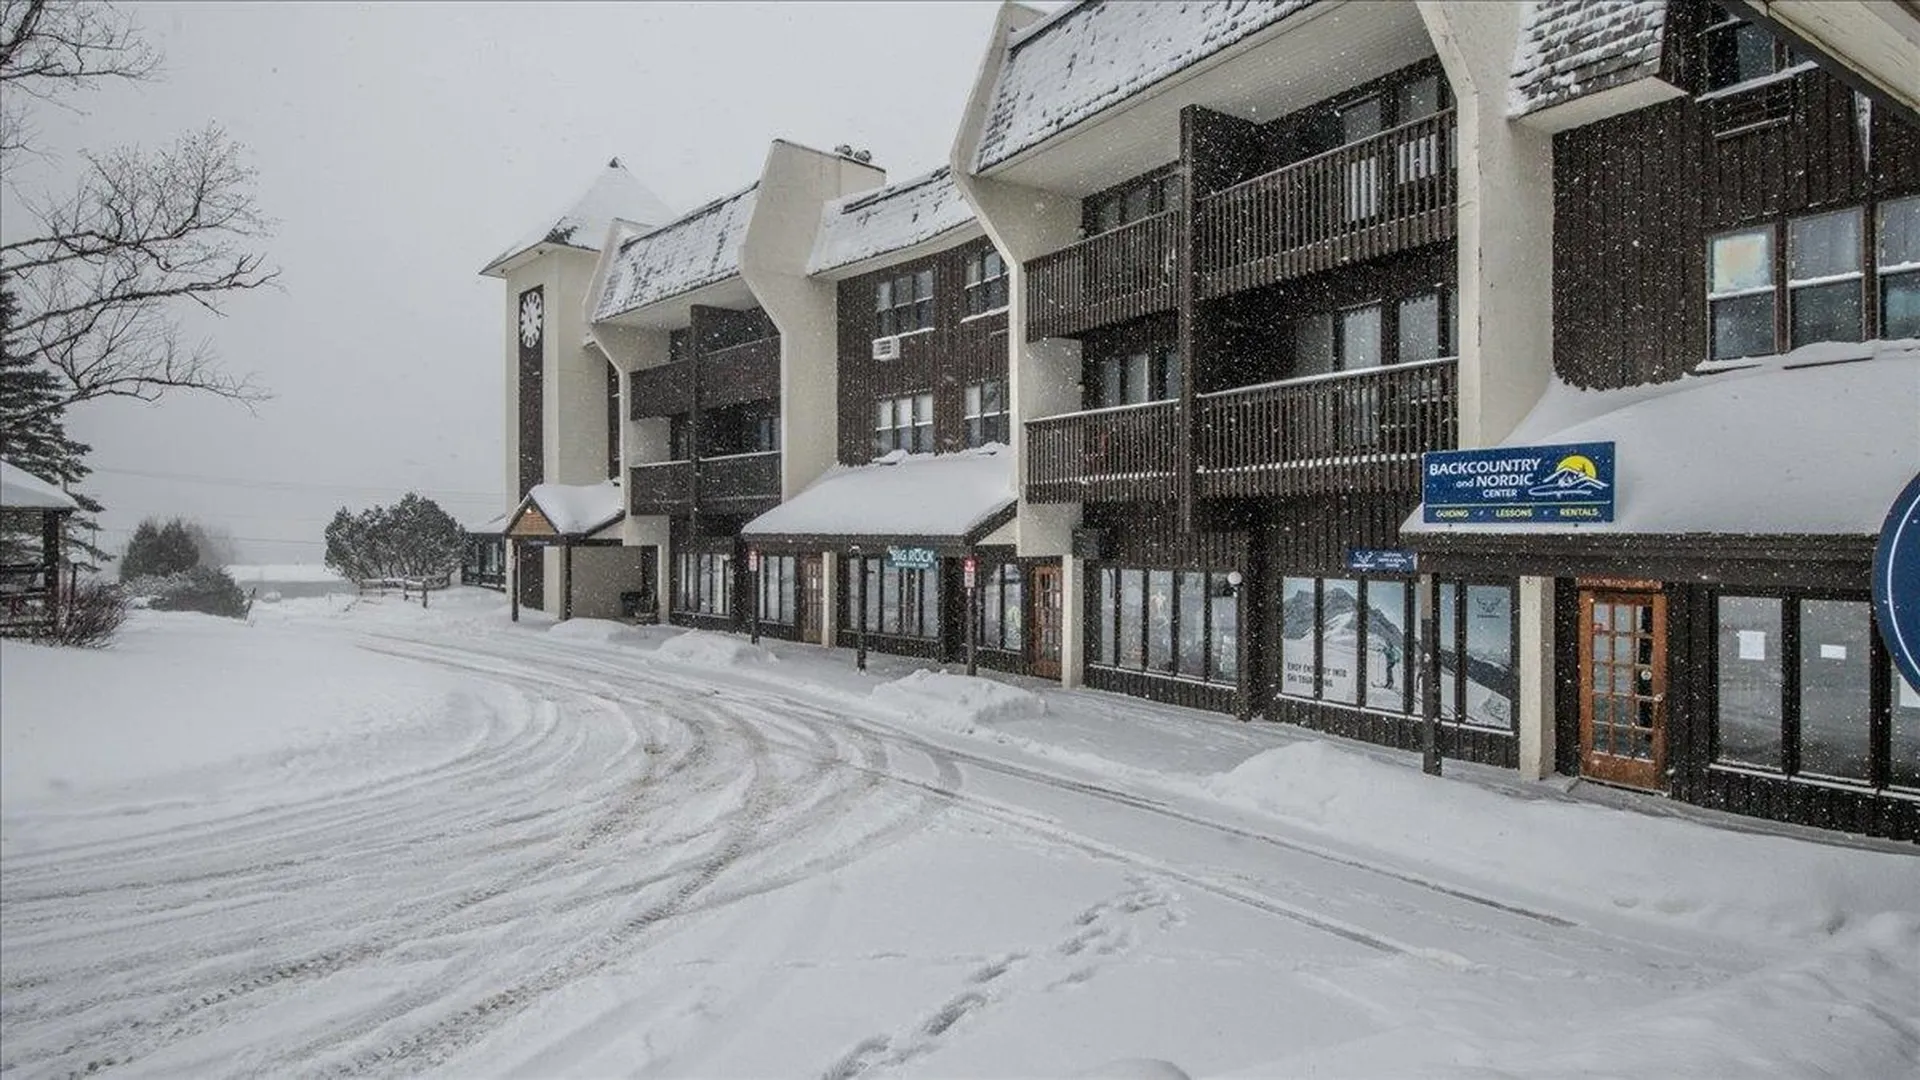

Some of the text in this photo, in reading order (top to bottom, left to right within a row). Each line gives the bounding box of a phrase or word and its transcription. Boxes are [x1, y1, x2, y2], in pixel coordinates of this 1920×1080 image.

[1429, 458, 1541, 476] BACKCOUNTRY
[1456, 473, 1534, 488] and NORDIC
[1482, 488, 1518, 498] CENTER
[1435, 507, 1599, 518] GUIDING LESSONS RENTALS
[892, 548, 935, 563] BIG ROCK
[1299, 675, 1334, 688] TOURNG
